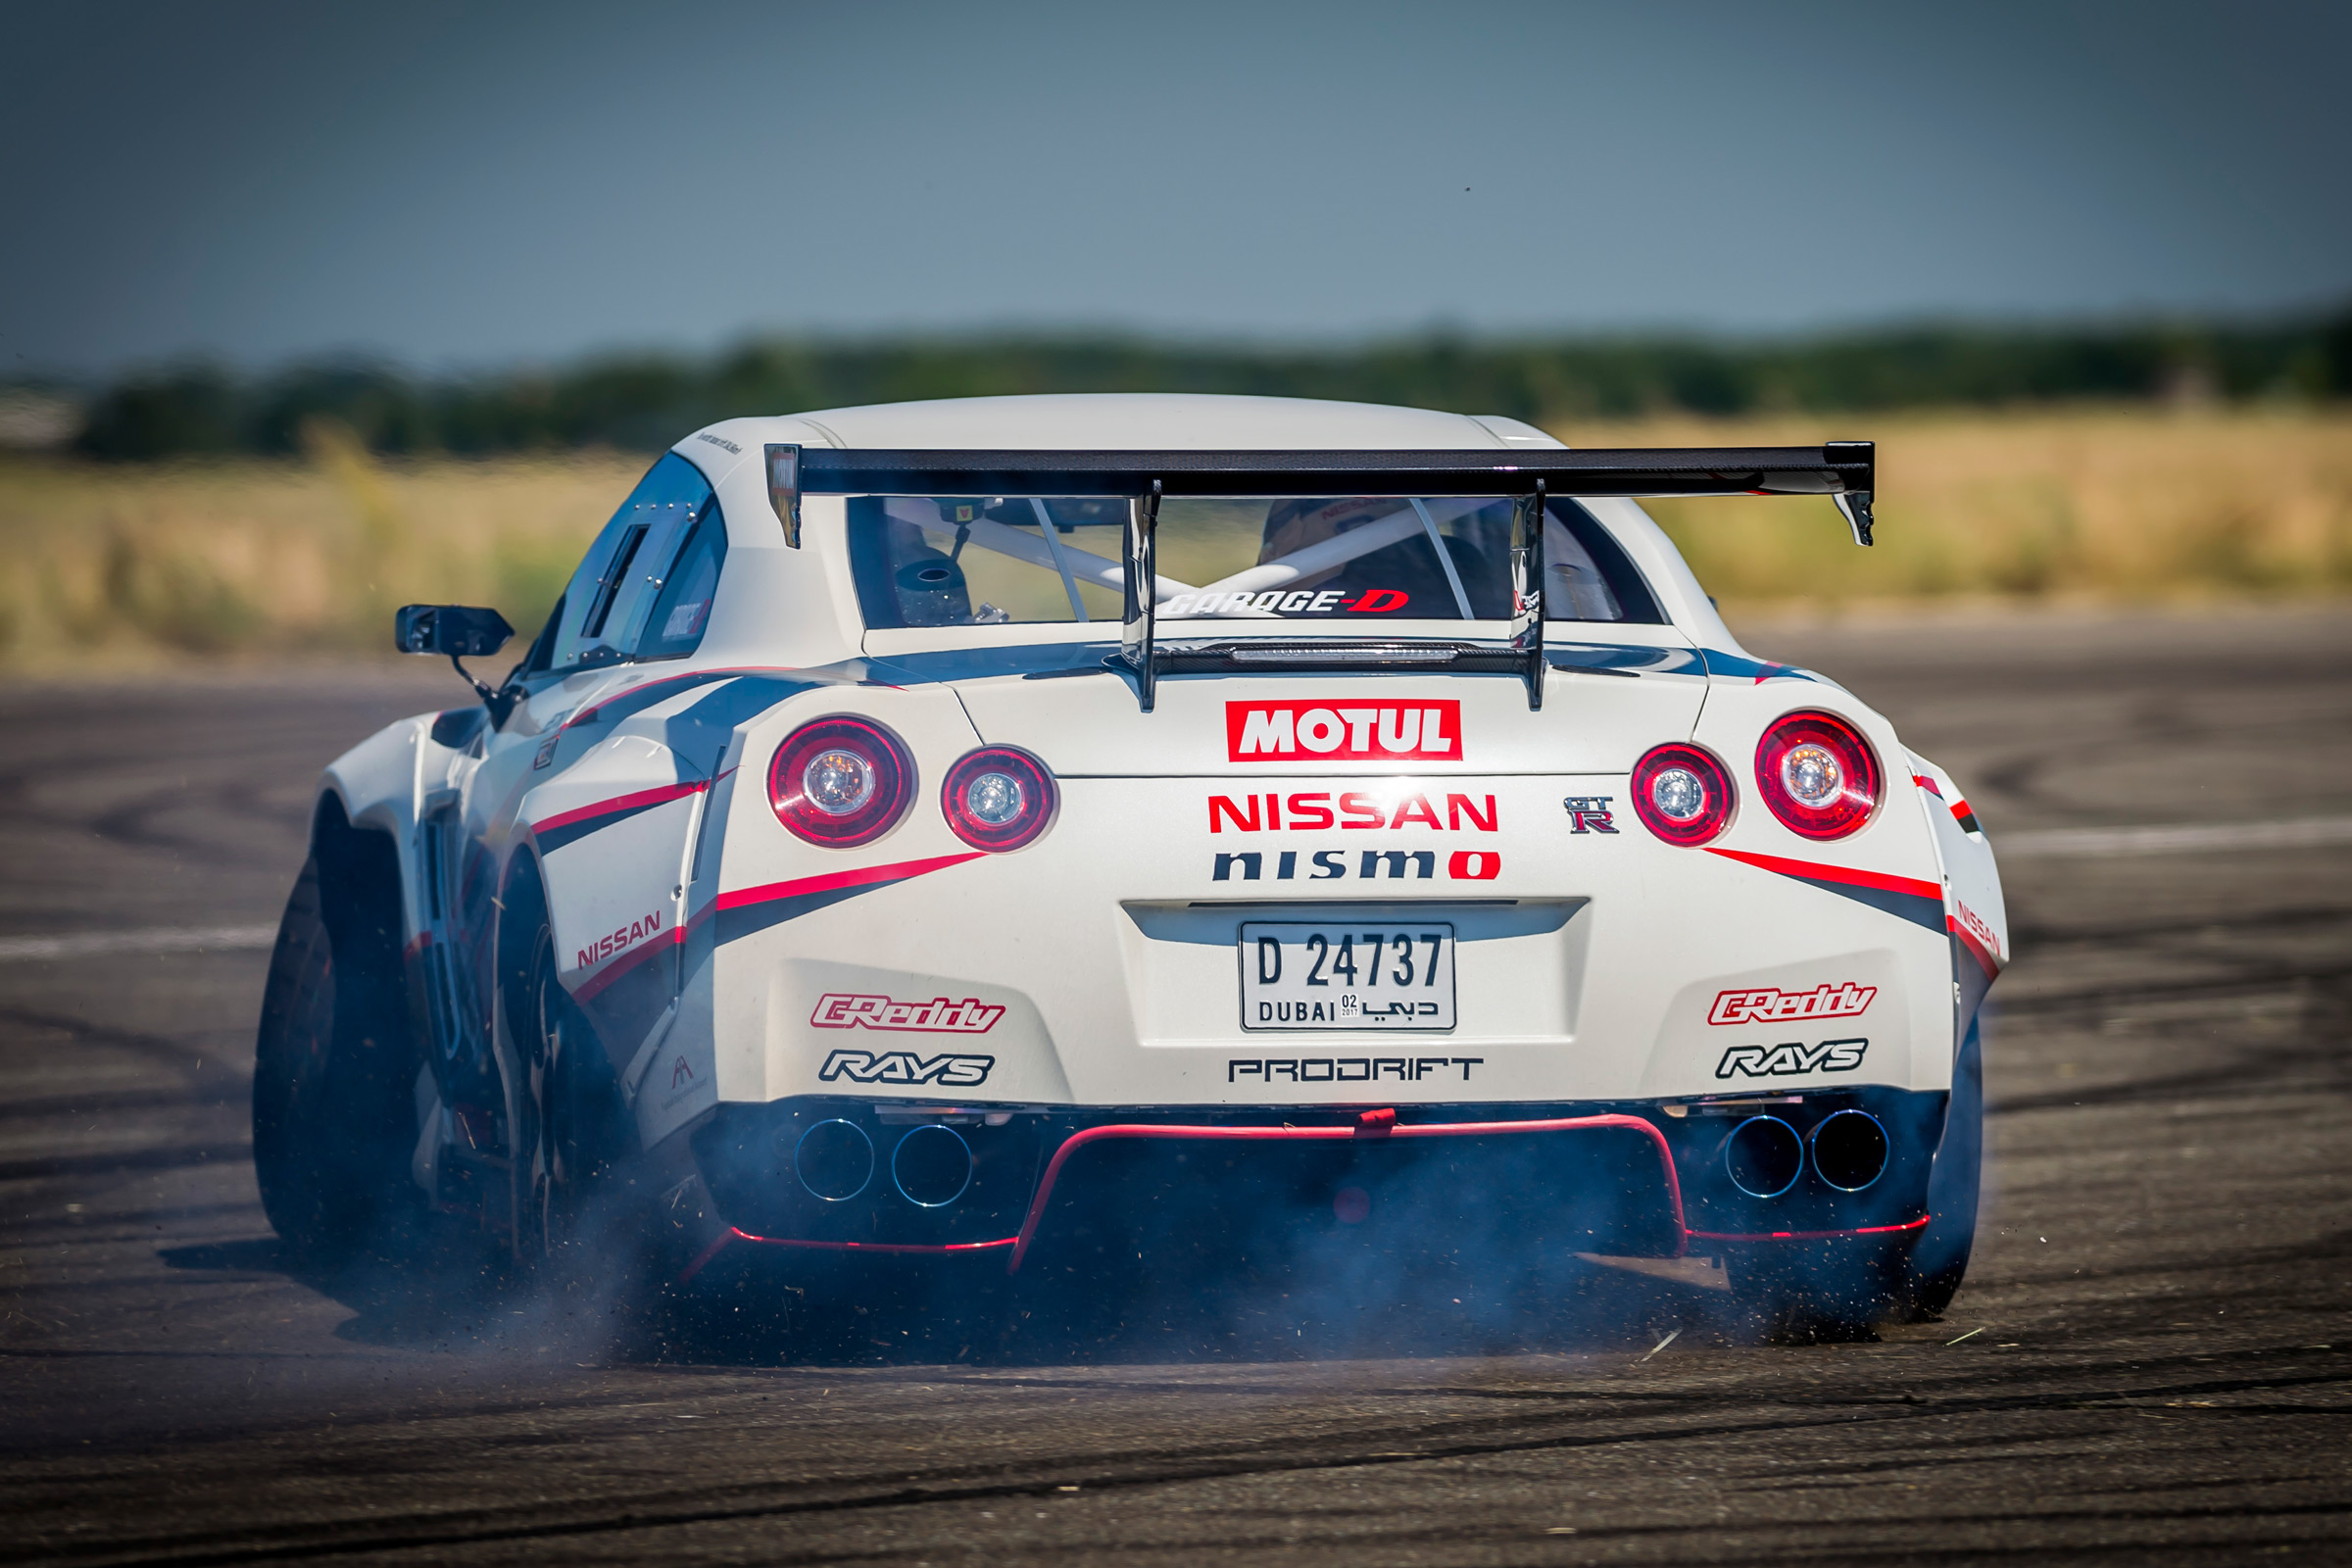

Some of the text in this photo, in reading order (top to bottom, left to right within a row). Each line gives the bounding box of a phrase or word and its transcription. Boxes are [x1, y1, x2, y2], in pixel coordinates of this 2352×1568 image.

[1161, 589, 1409, 615] GARAGE-D
[1238, 708, 1452, 754] MOTUL
[1208, 793, 1498, 834] NISSAN
[1212, 850, 1501, 882] nismo
[577, 909, 661, 971] NISSAN
[1957, 900, 2001, 957] NISSAN
[1257, 934, 1443, 987] D 24737
[1259, 1002, 1336, 1022] DUBAI
[1342, 995, 1357, 1008] 02
[1362, 1002, 1439, 1022] دبي
[818, 1050, 996, 1087] RAYS
[1228, 1057, 1485, 1083] PRODRIFT
[1715, 1038, 1869, 1079] RAYS
